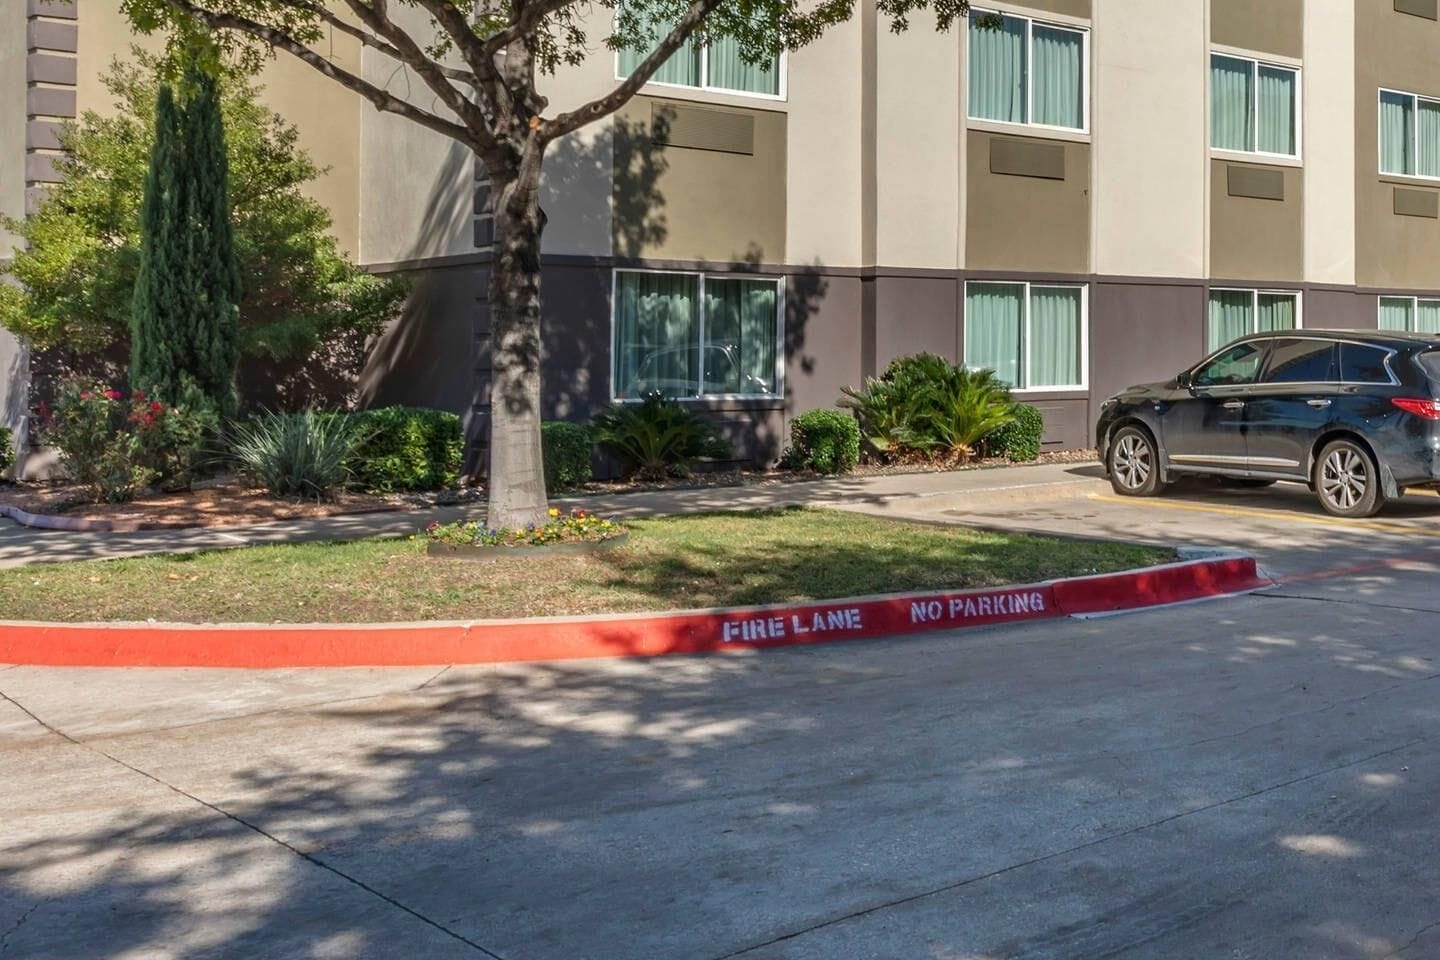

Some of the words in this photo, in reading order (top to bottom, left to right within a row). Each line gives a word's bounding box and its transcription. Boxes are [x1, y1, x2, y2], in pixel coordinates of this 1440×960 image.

[723, 617, 785, 642] FIRE
[792, 609, 862, 634] LANE
[911, 601, 942, 623] NO
[949, 592, 1044, 618] PARKING
